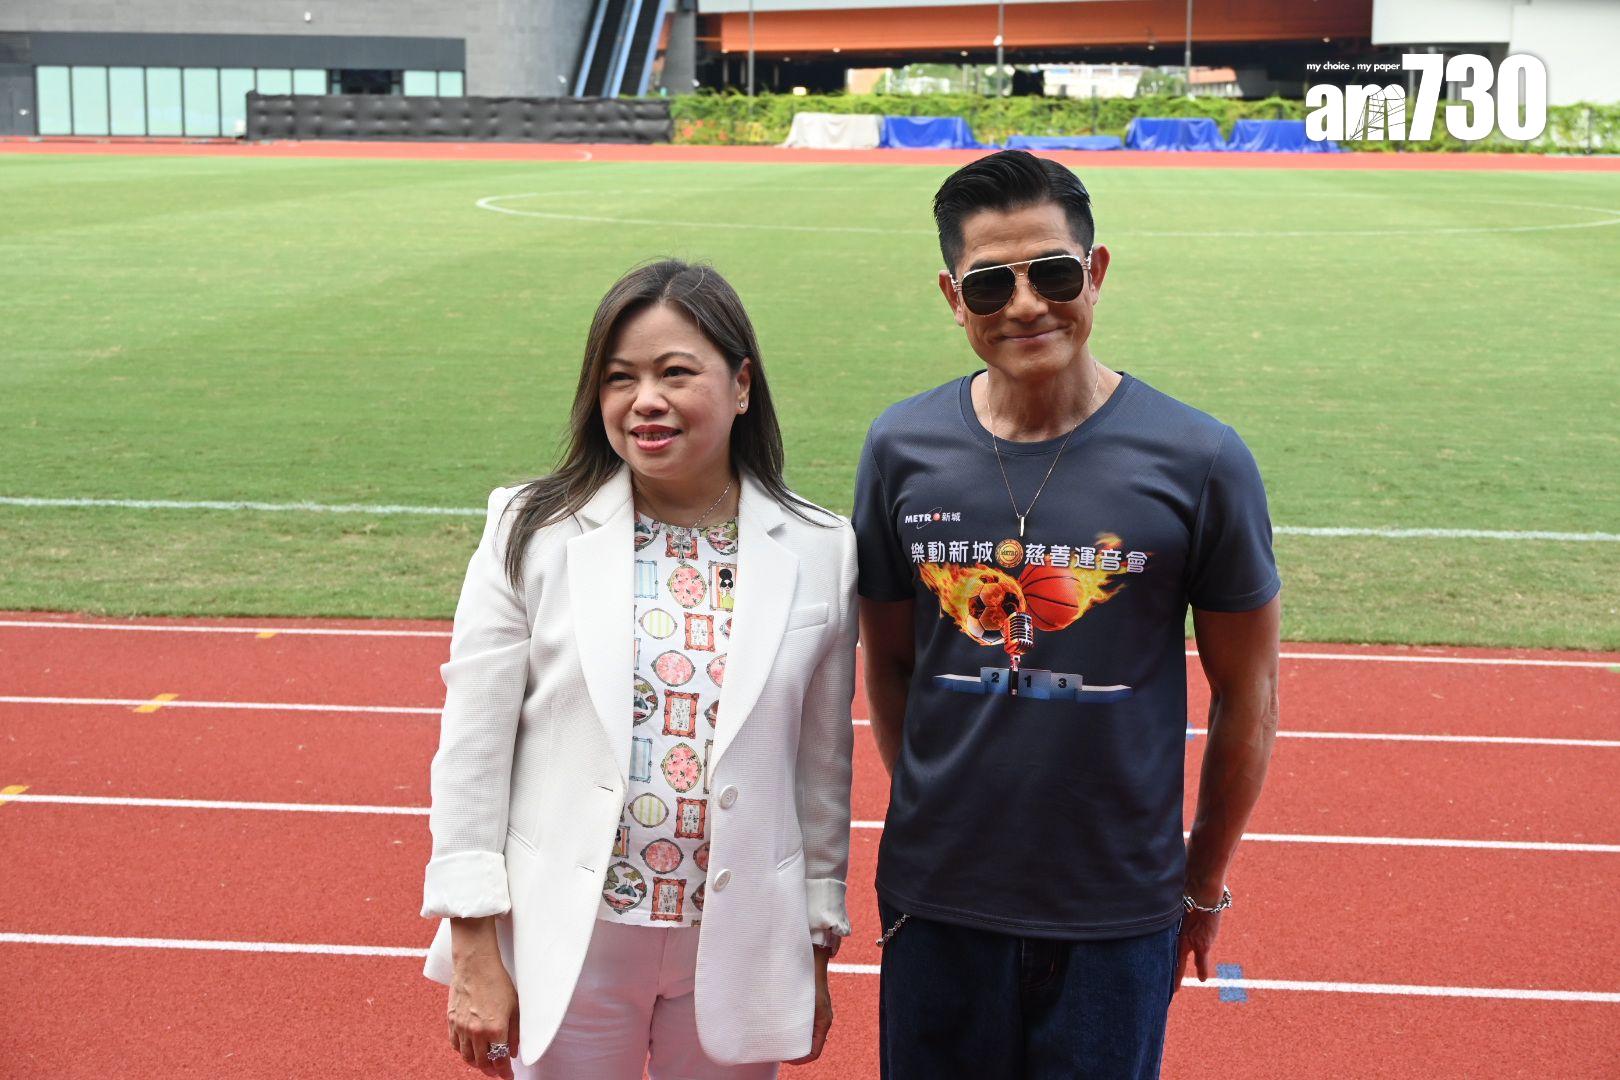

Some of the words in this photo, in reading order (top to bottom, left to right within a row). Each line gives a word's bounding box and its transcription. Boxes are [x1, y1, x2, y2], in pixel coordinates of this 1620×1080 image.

[942, 512, 961, 521] 新城
[911, 541, 993, 563] 樂動新城
[1025, 543, 1148, 573] 慈善運音會
[991, 672, 999, 683] 2
[1024, 675, 1031, 688] 1
[1058, 678, 1067, 688] 3
